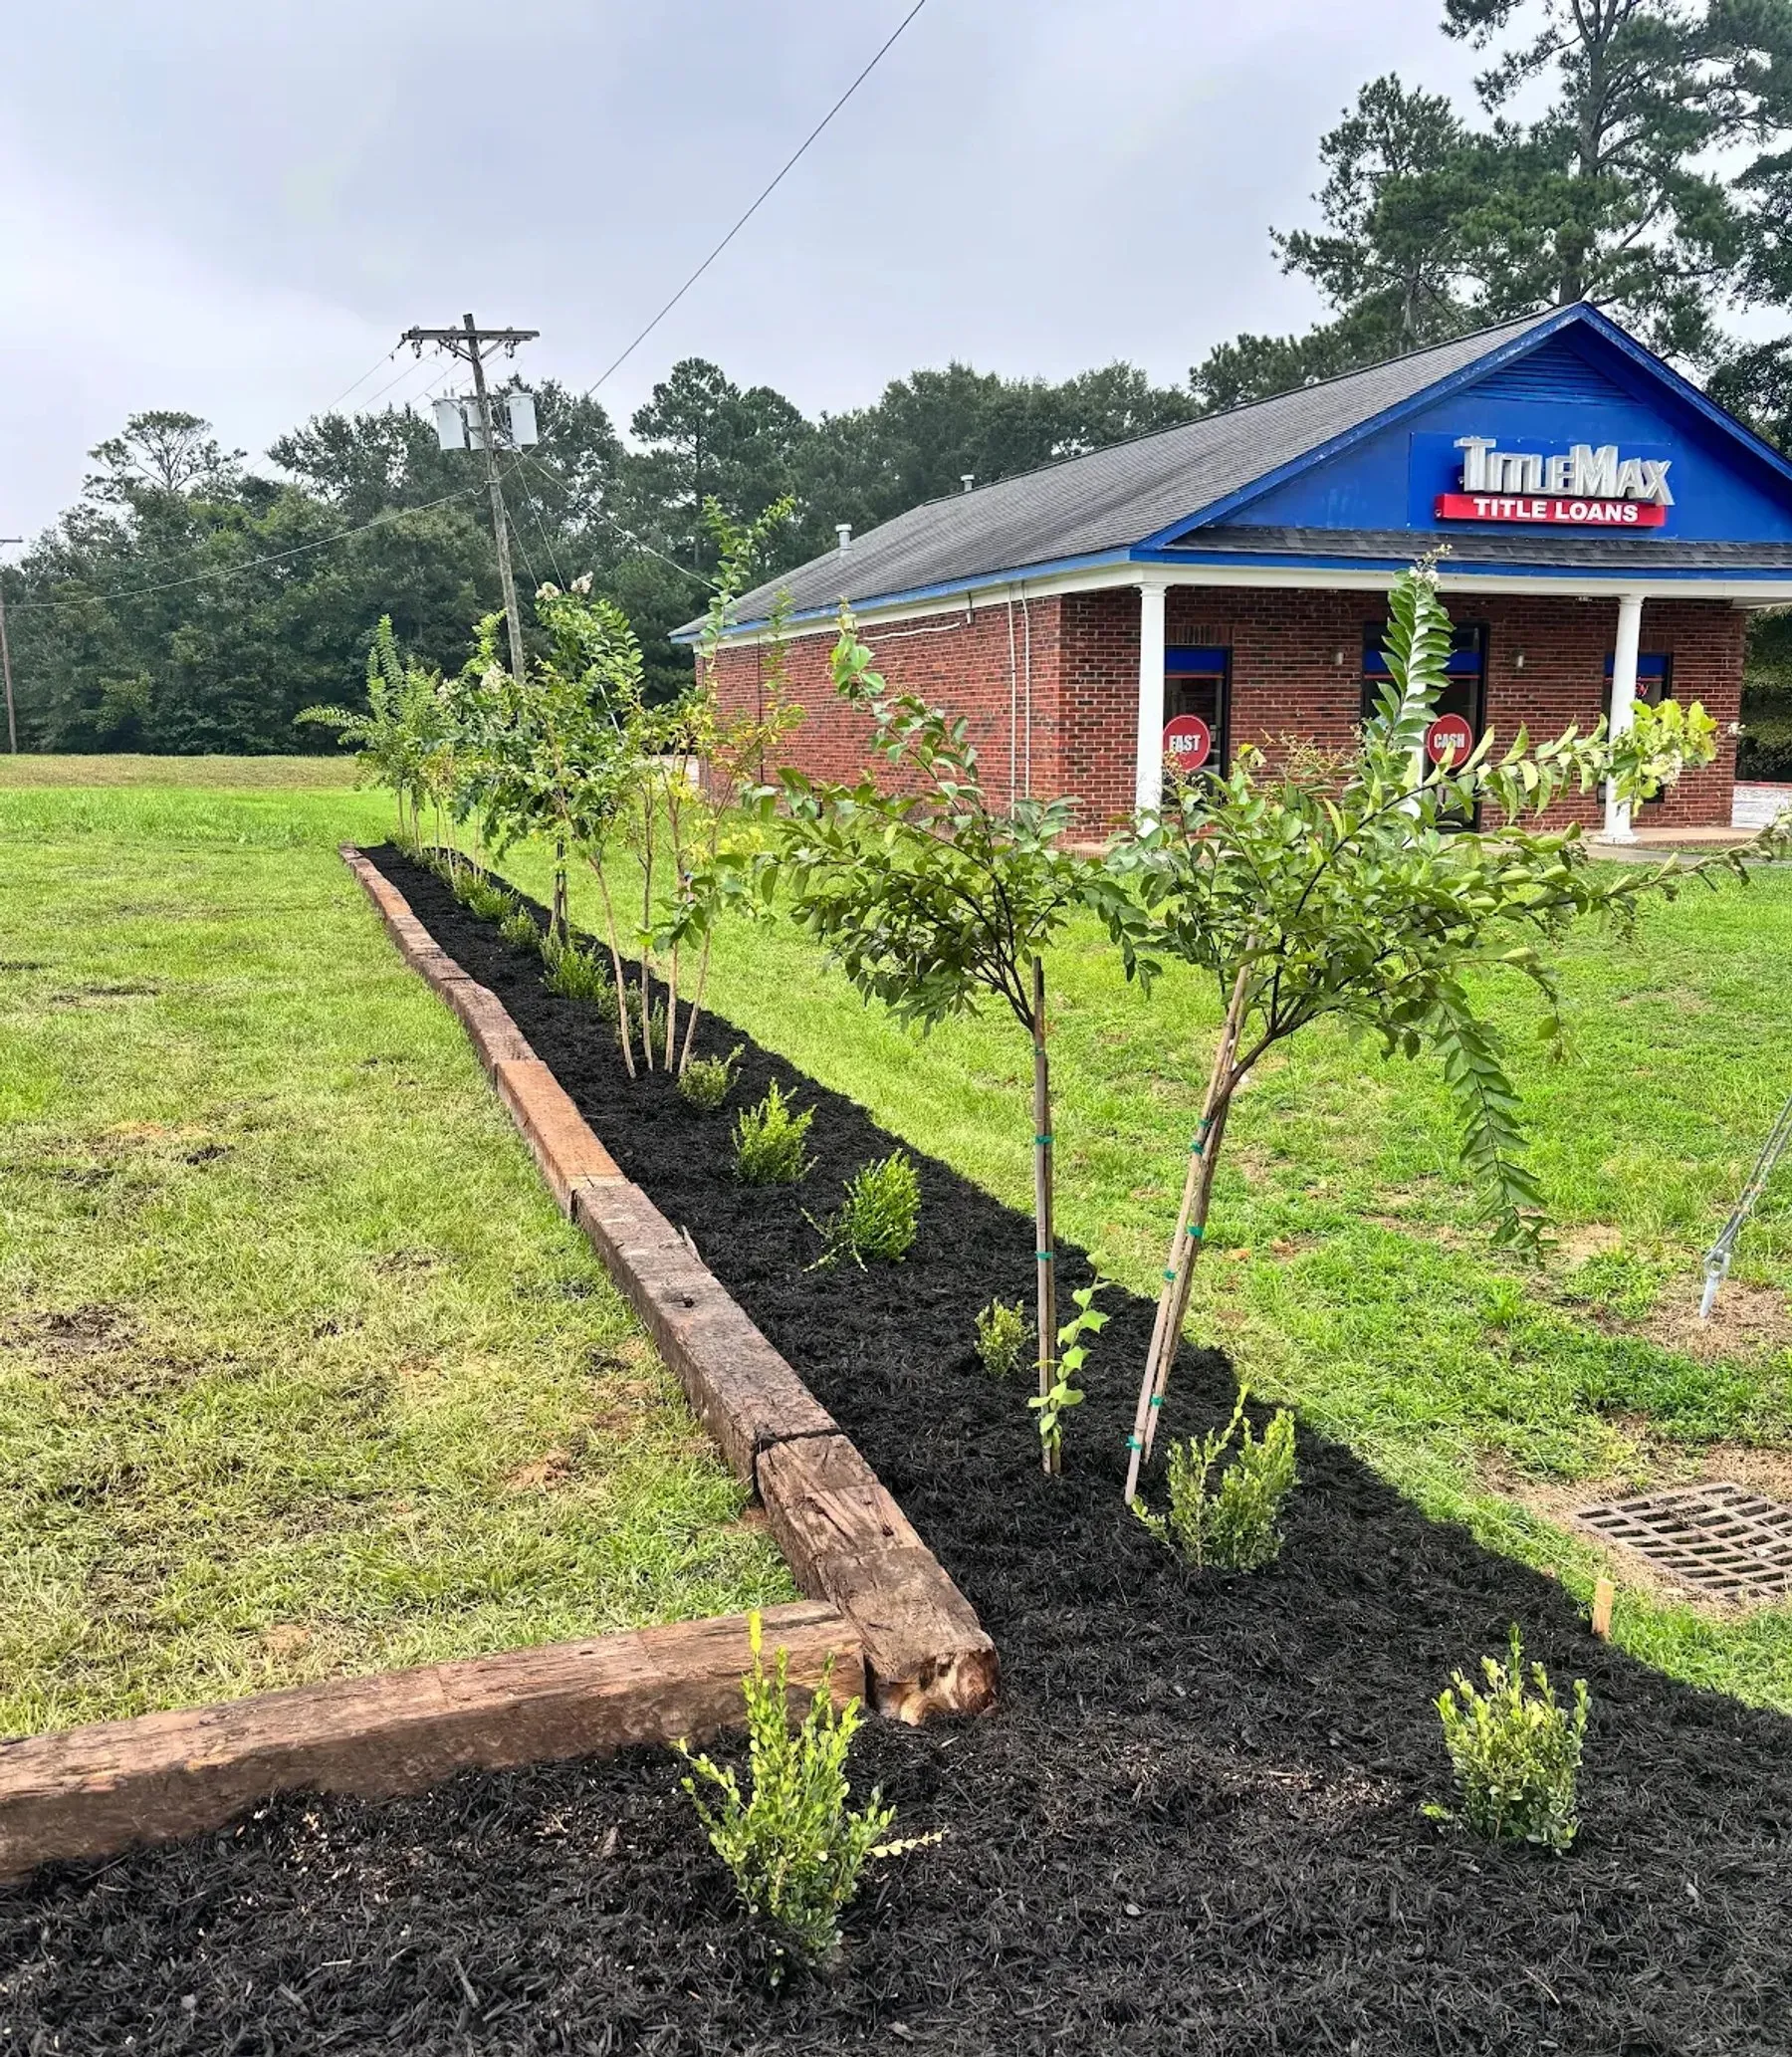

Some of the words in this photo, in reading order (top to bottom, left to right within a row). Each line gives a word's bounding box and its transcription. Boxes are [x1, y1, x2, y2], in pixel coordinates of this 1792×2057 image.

[1473, 498, 1547, 519] TITLE
[1555, 501, 1639, 523] LOANS
[1169, 735, 1201, 752] FAST
